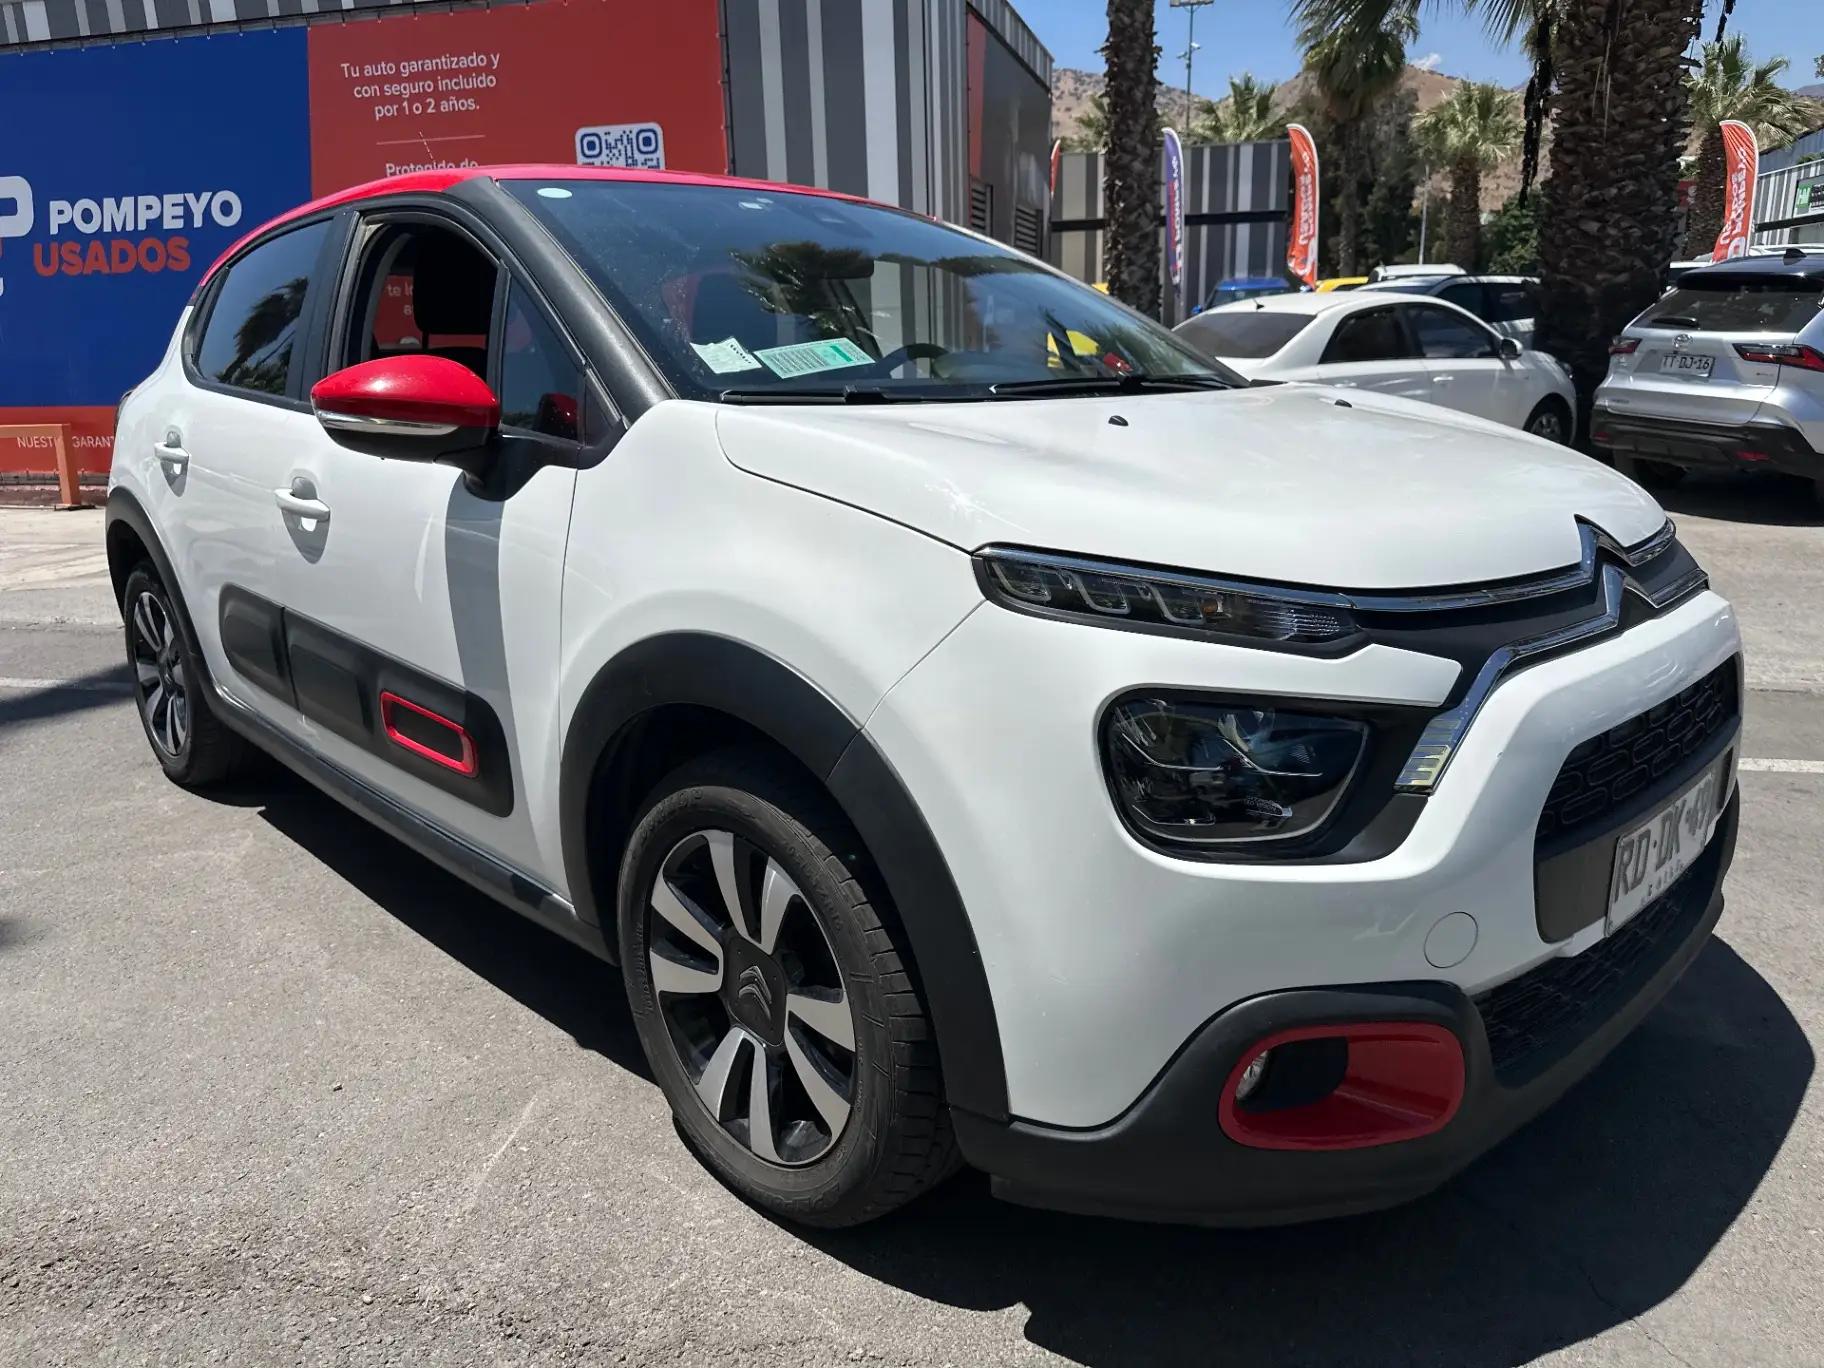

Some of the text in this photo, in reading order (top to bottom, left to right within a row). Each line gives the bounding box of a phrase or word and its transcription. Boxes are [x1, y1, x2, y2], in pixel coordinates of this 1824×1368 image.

[341, 51, 500, 78] Tu auto garantizado y
[353, 73, 497, 98] con seguro incluido
[375, 96, 480, 121] por 1 o 2 años.
[49, 190, 242, 235] POMPEYO
[33, 236, 191, 277] USADOS
[16, 436, 58, 449] NUEST
